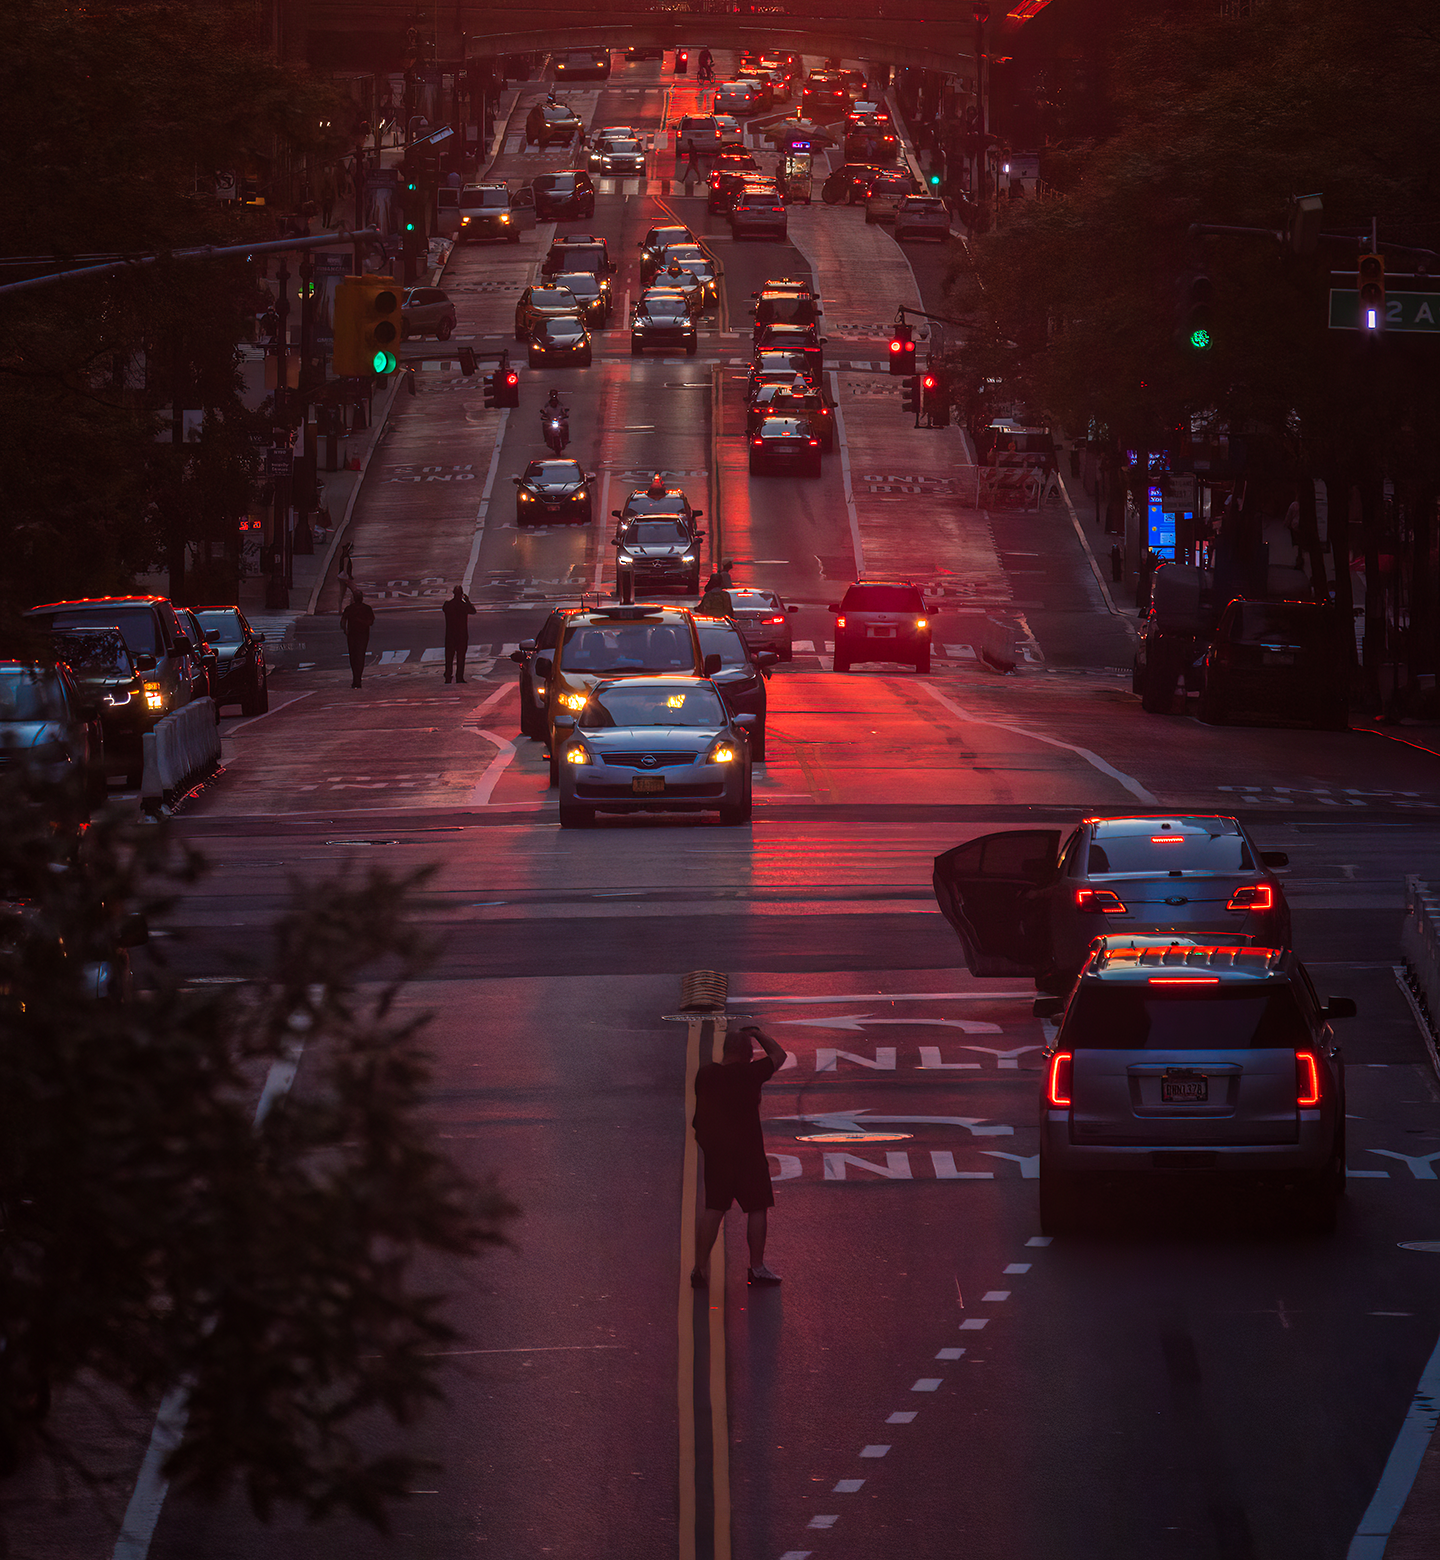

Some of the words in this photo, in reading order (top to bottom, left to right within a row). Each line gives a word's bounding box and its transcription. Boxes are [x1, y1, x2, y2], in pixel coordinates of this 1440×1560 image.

[1413, 301, 1440, 324] A
[381, 473, 475, 484] ONLY
[863, 475, 957, 484] ONLY
[362, 588, 448, 599] ONL
